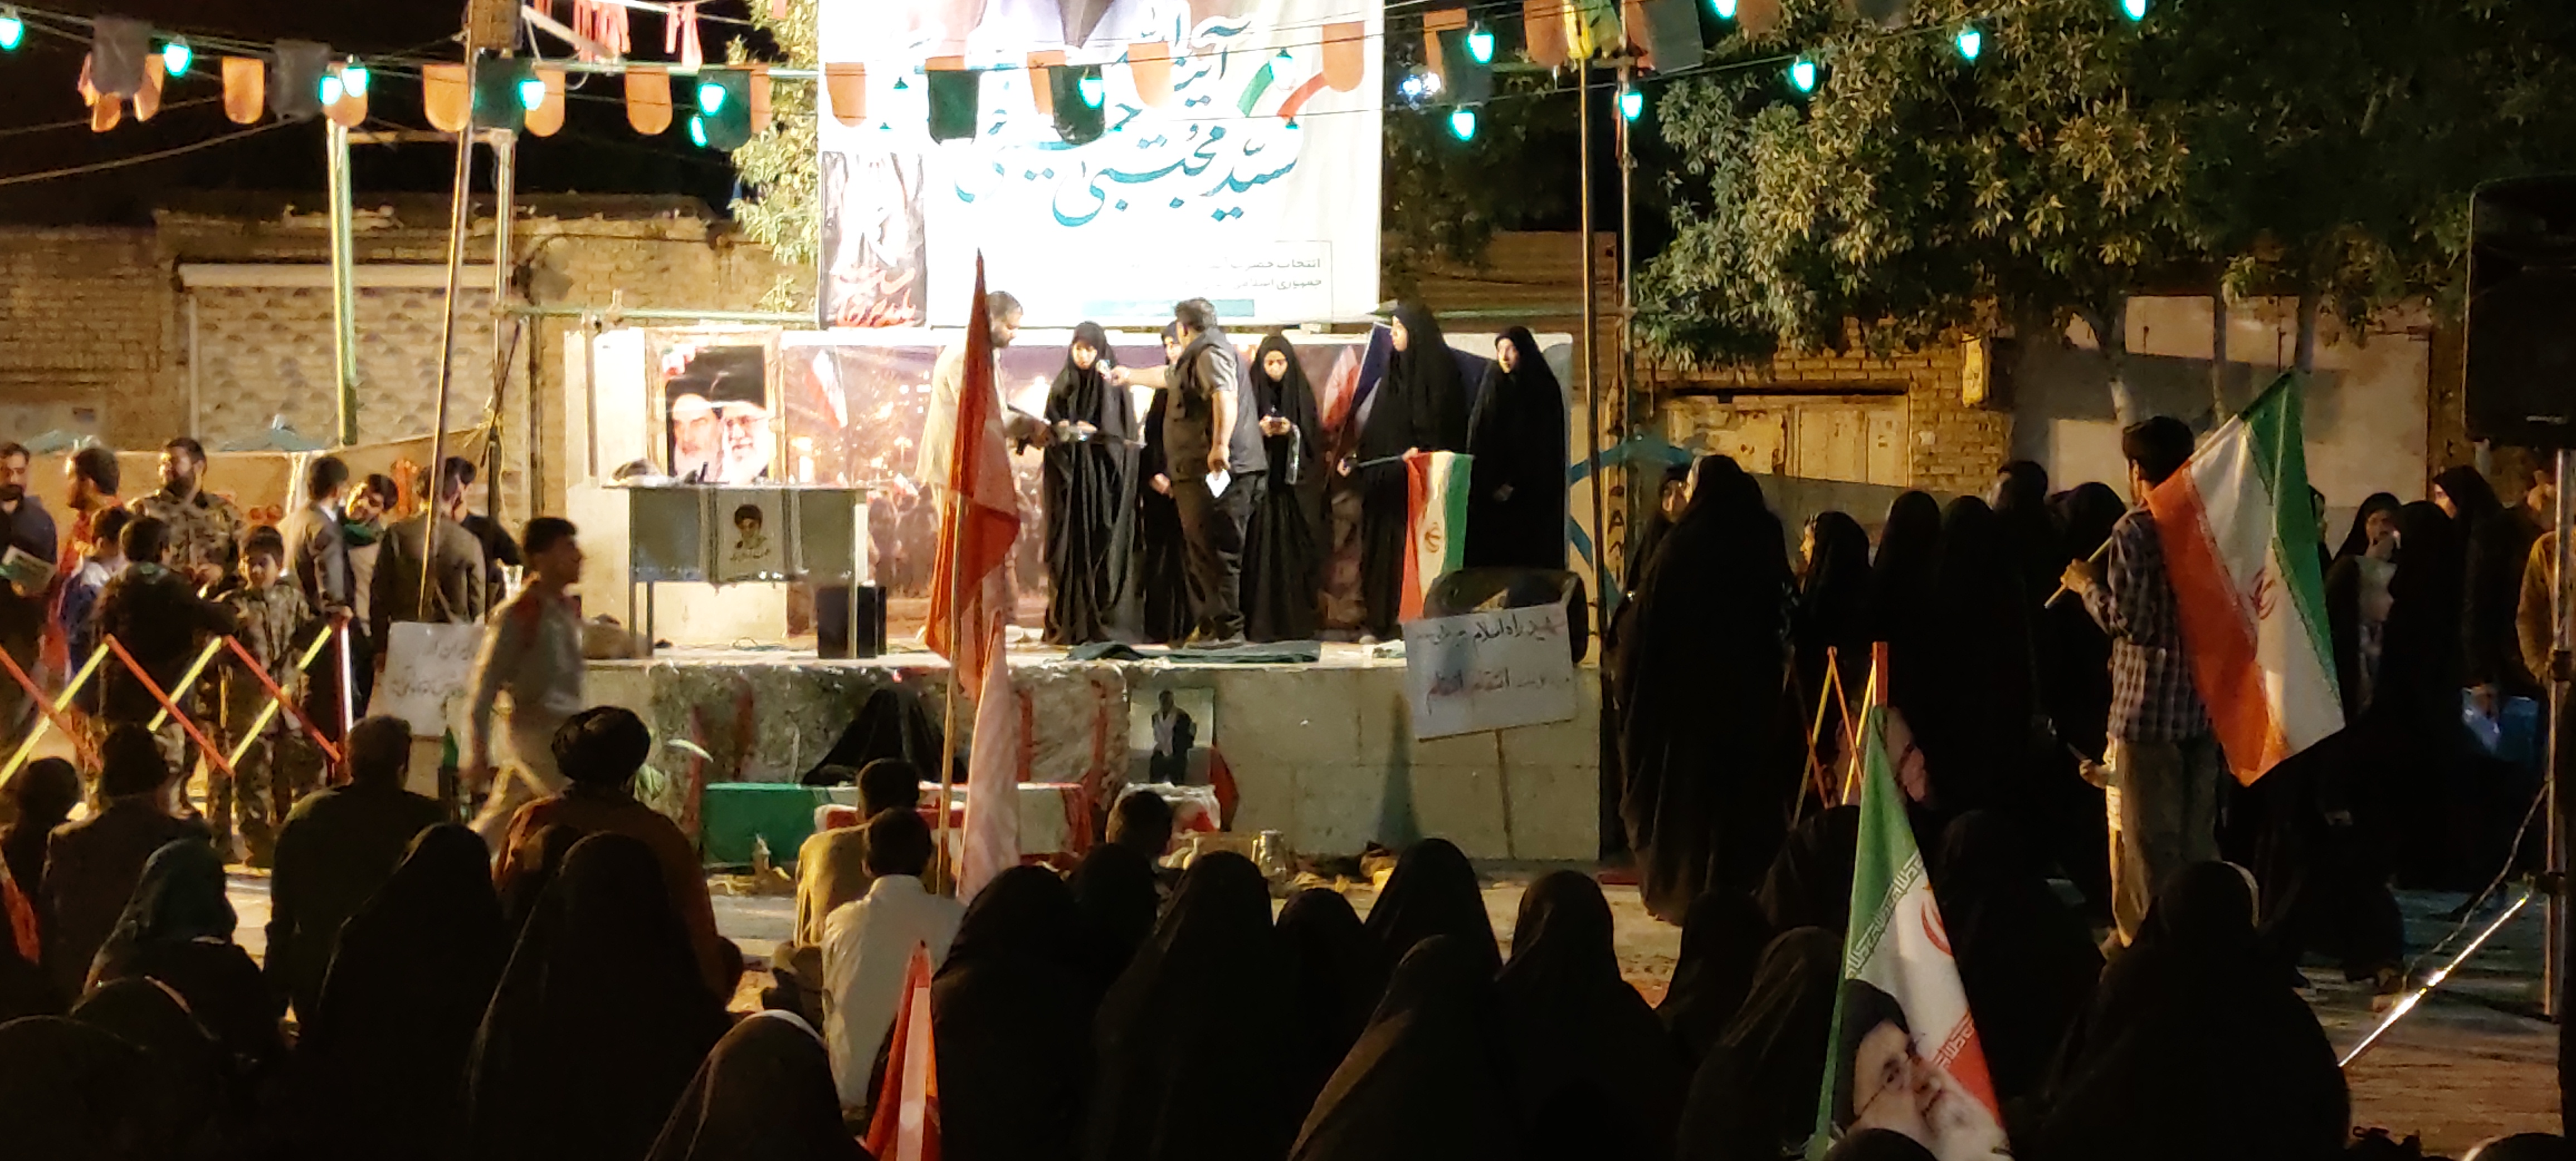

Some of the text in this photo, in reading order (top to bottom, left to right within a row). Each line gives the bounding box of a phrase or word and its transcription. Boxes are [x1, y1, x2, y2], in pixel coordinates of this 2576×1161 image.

[1276, 258, 1321, 270] انتخاب
[1276, 278, 1323, 291] جمهوری
[1473, 618, 1504, 655] اسلام
